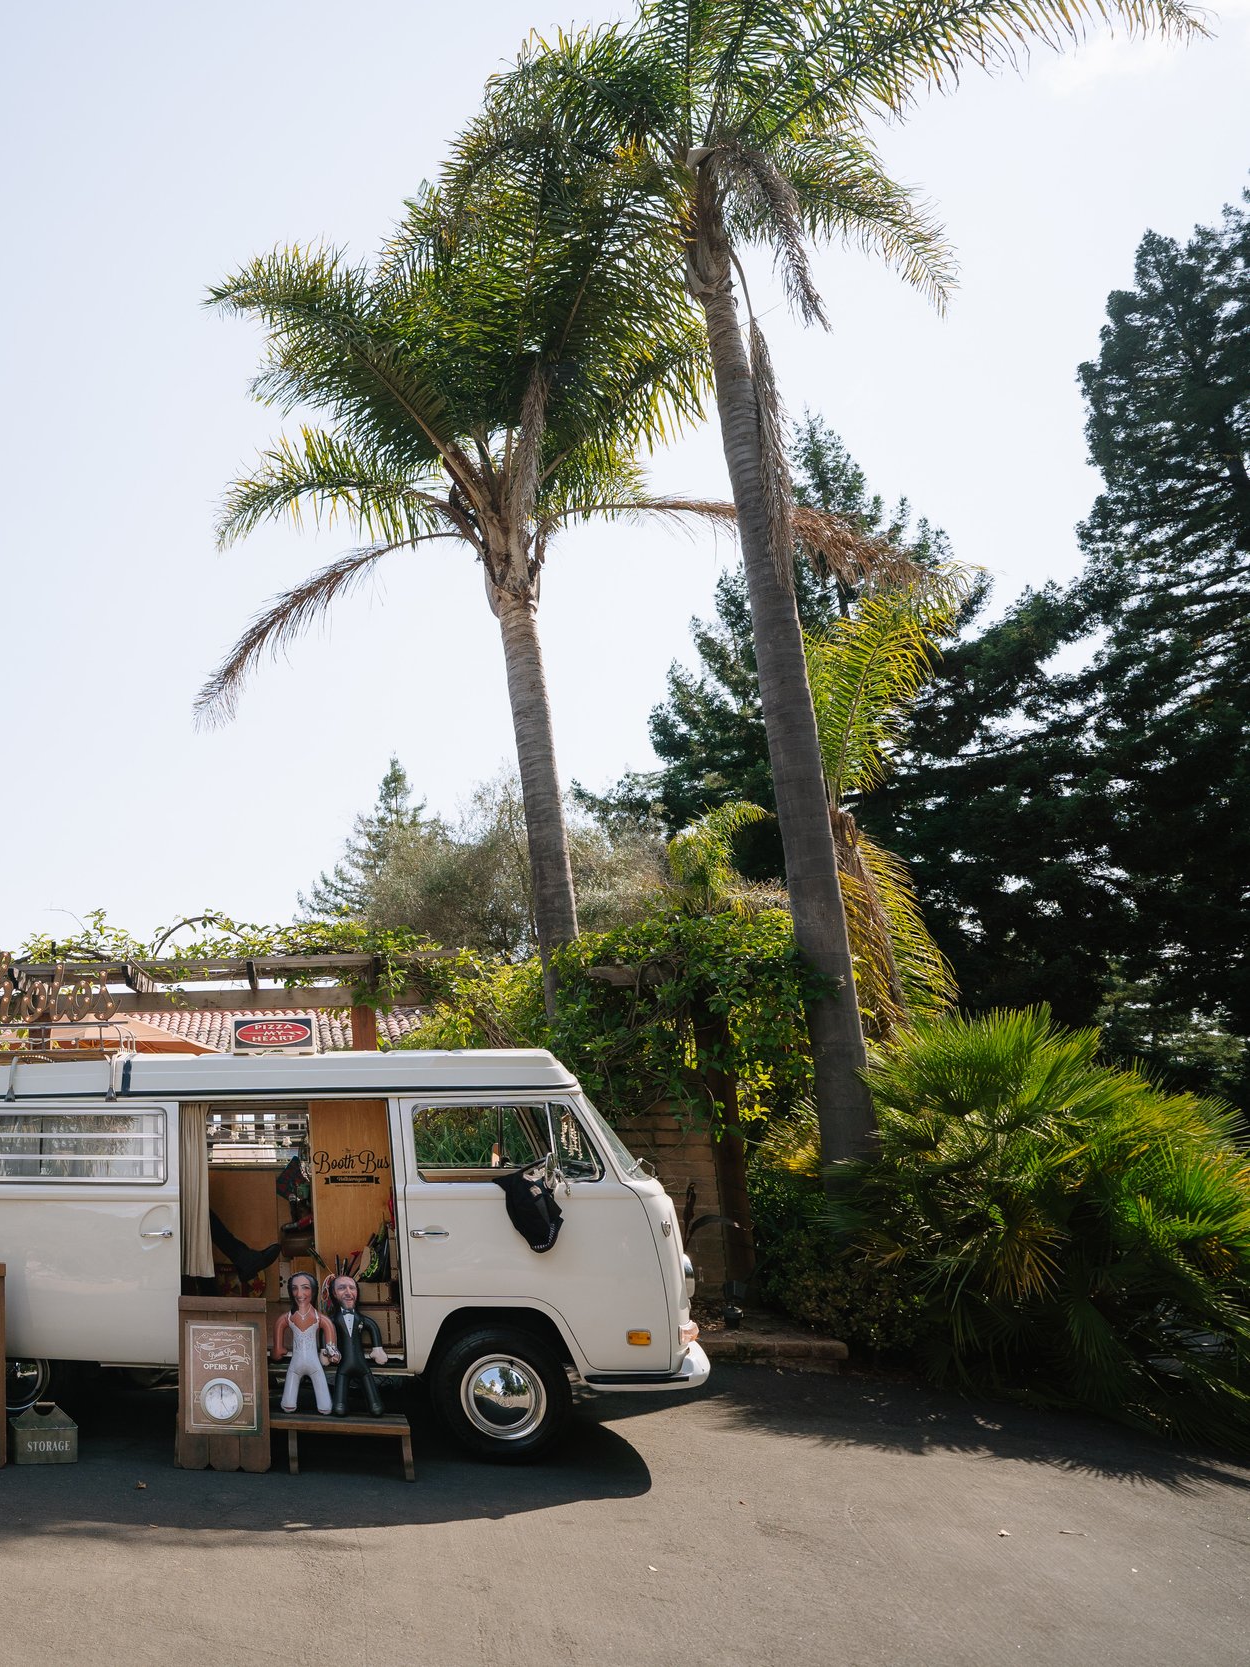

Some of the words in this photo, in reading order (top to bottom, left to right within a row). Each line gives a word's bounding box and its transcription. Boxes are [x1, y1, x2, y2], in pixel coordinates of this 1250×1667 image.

[313, 1150, 357, 1174] Booth
[358, 1150, 390, 1174] Bus
[203, 1363, 228, 1371] OPENS
[27, 1440, 71, 1452] STORAGE
